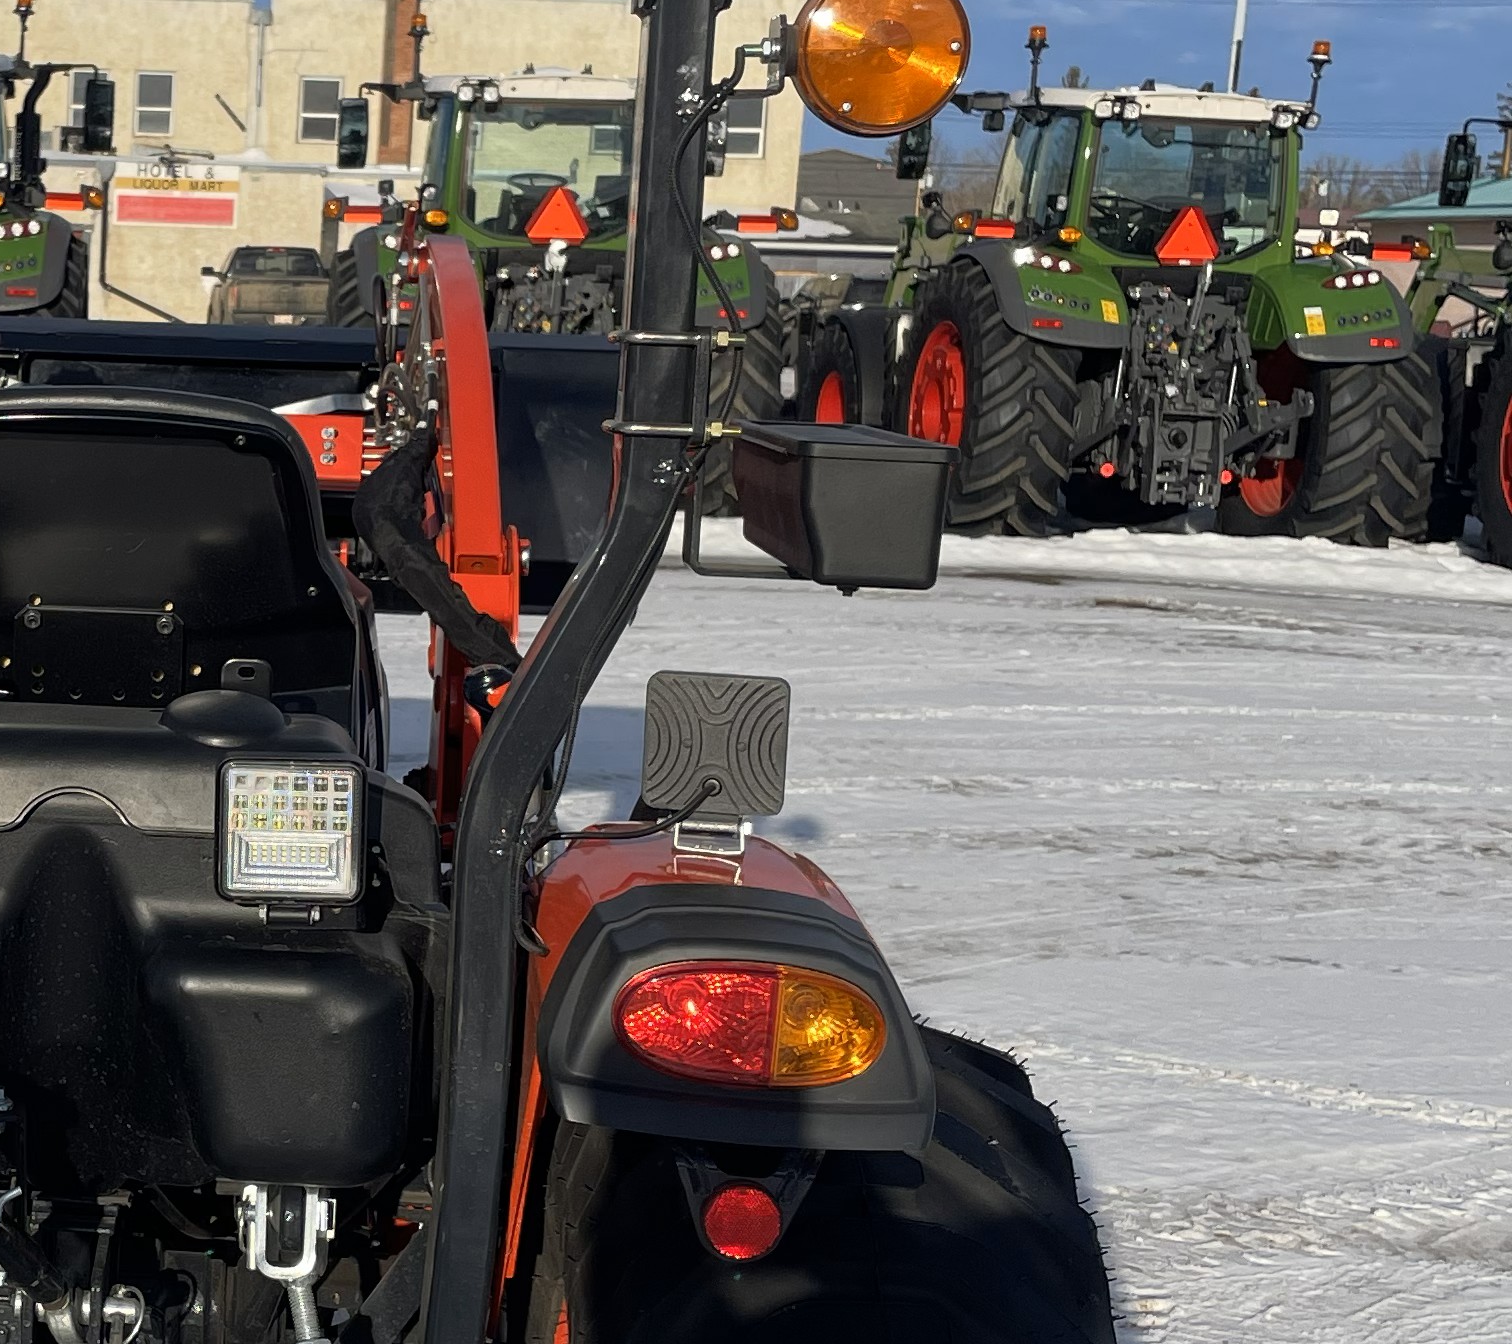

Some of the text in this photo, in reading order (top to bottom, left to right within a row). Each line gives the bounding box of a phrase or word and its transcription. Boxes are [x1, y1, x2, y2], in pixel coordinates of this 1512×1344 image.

[204, 166, 215, 179] &
[132, 179, 224, 191] LIQUOR MART
